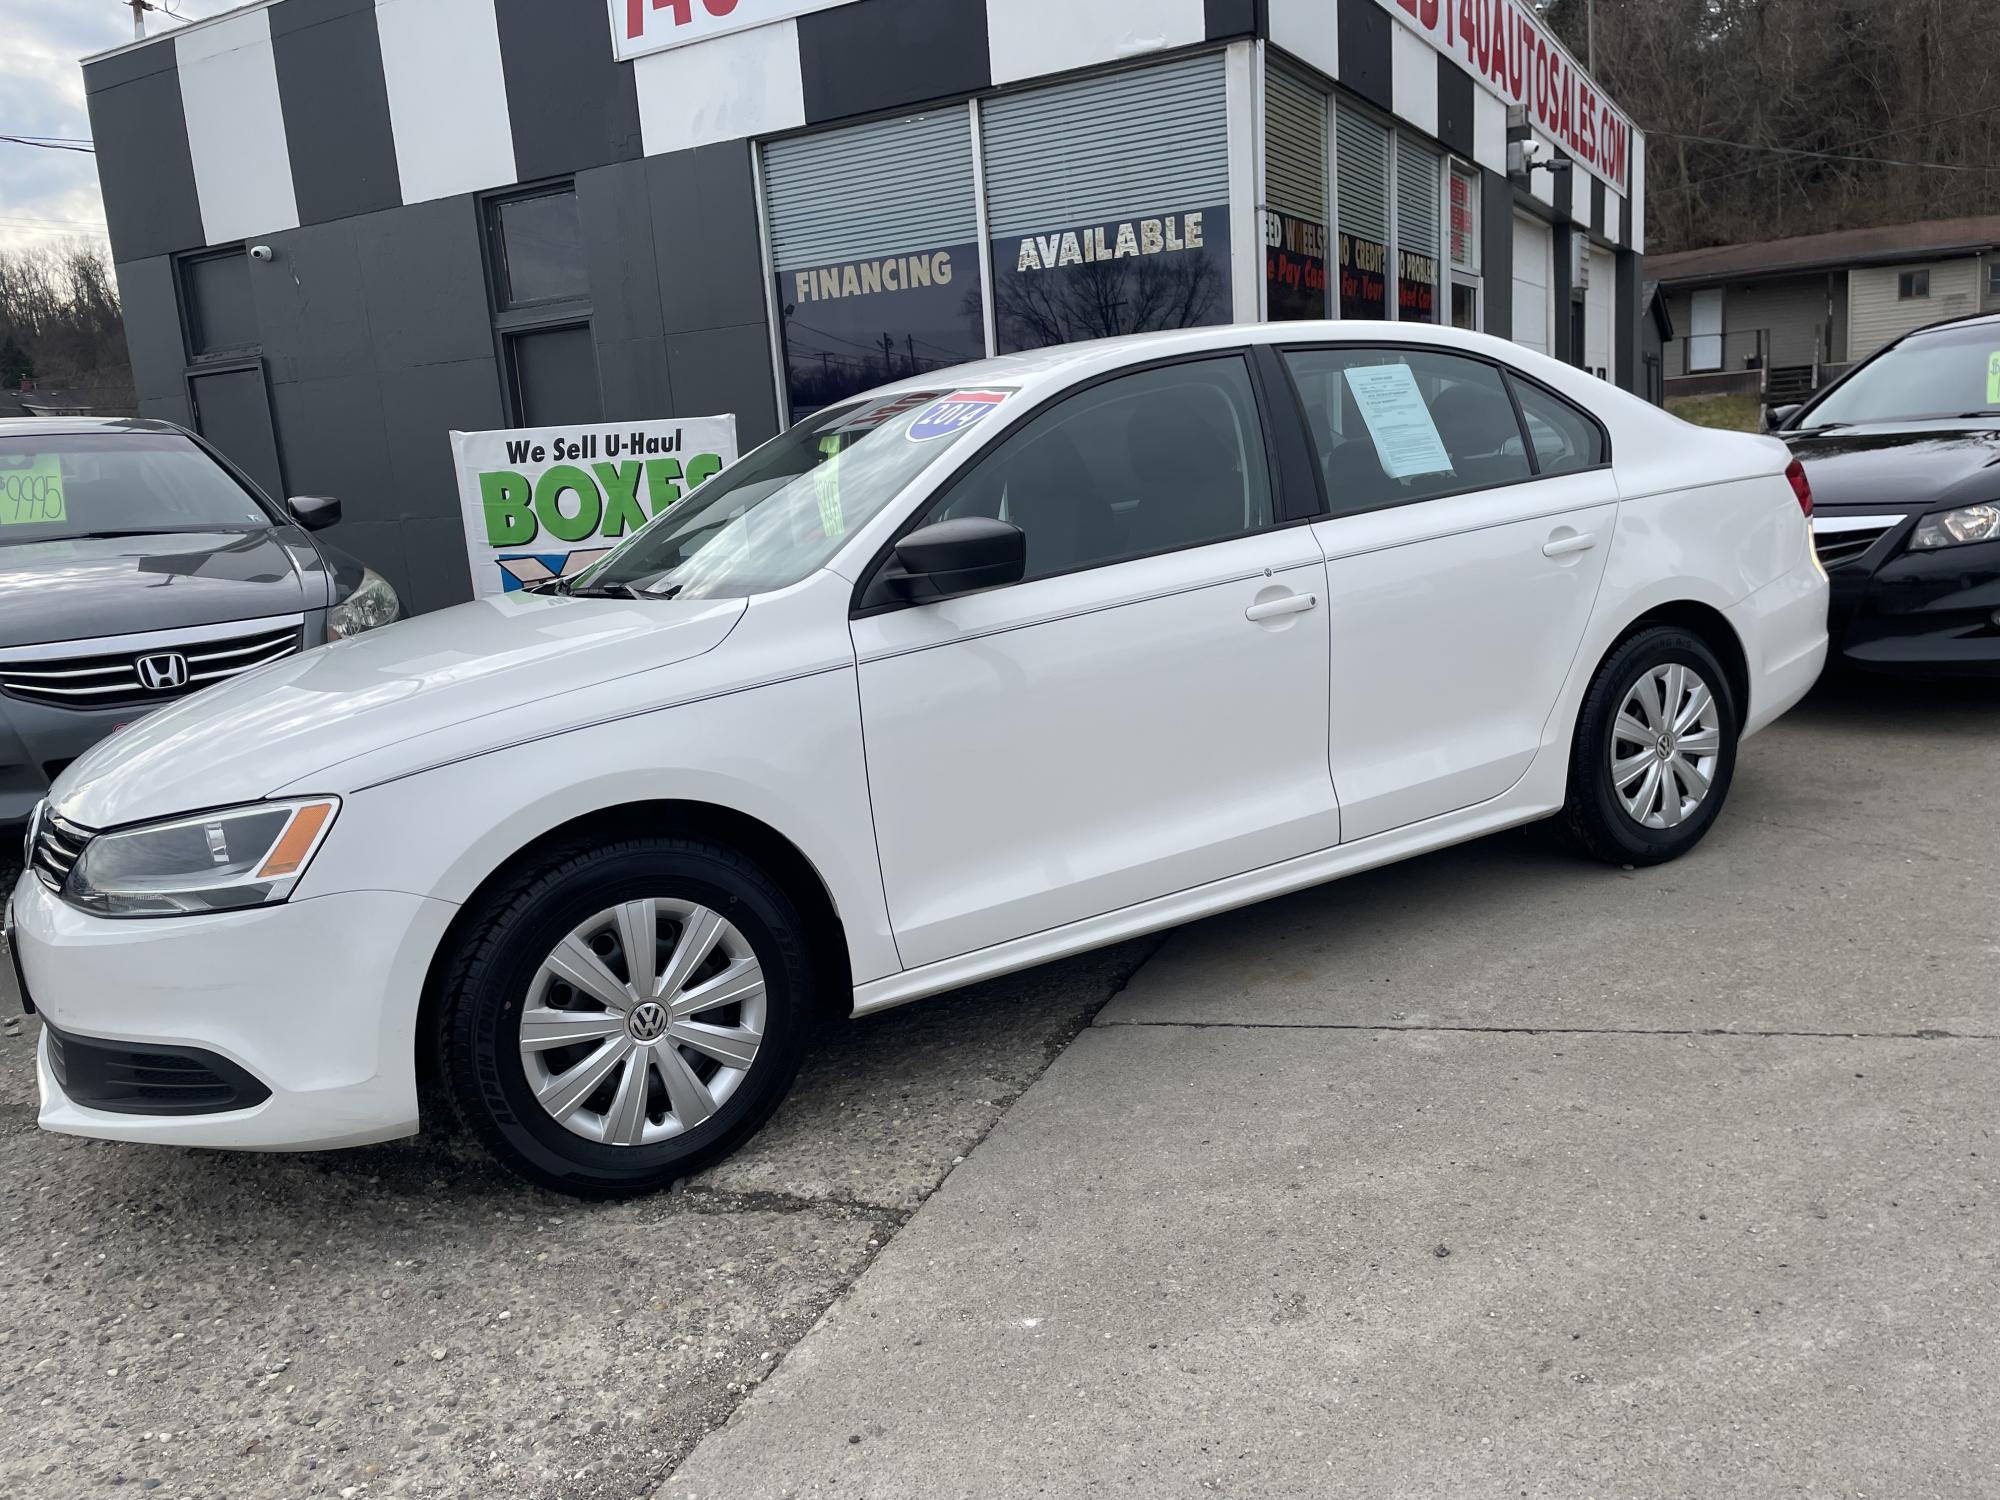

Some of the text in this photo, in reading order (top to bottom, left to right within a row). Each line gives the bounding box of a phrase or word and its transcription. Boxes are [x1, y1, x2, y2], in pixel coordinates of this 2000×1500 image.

[795, 212, 1204, 303] FINANCING AVAILABLE
[1278, 253, 1301, 289] Pay
[917, 402, 990, 426] 2014
[505, 428, 682, 465] We Sell U-Haul
